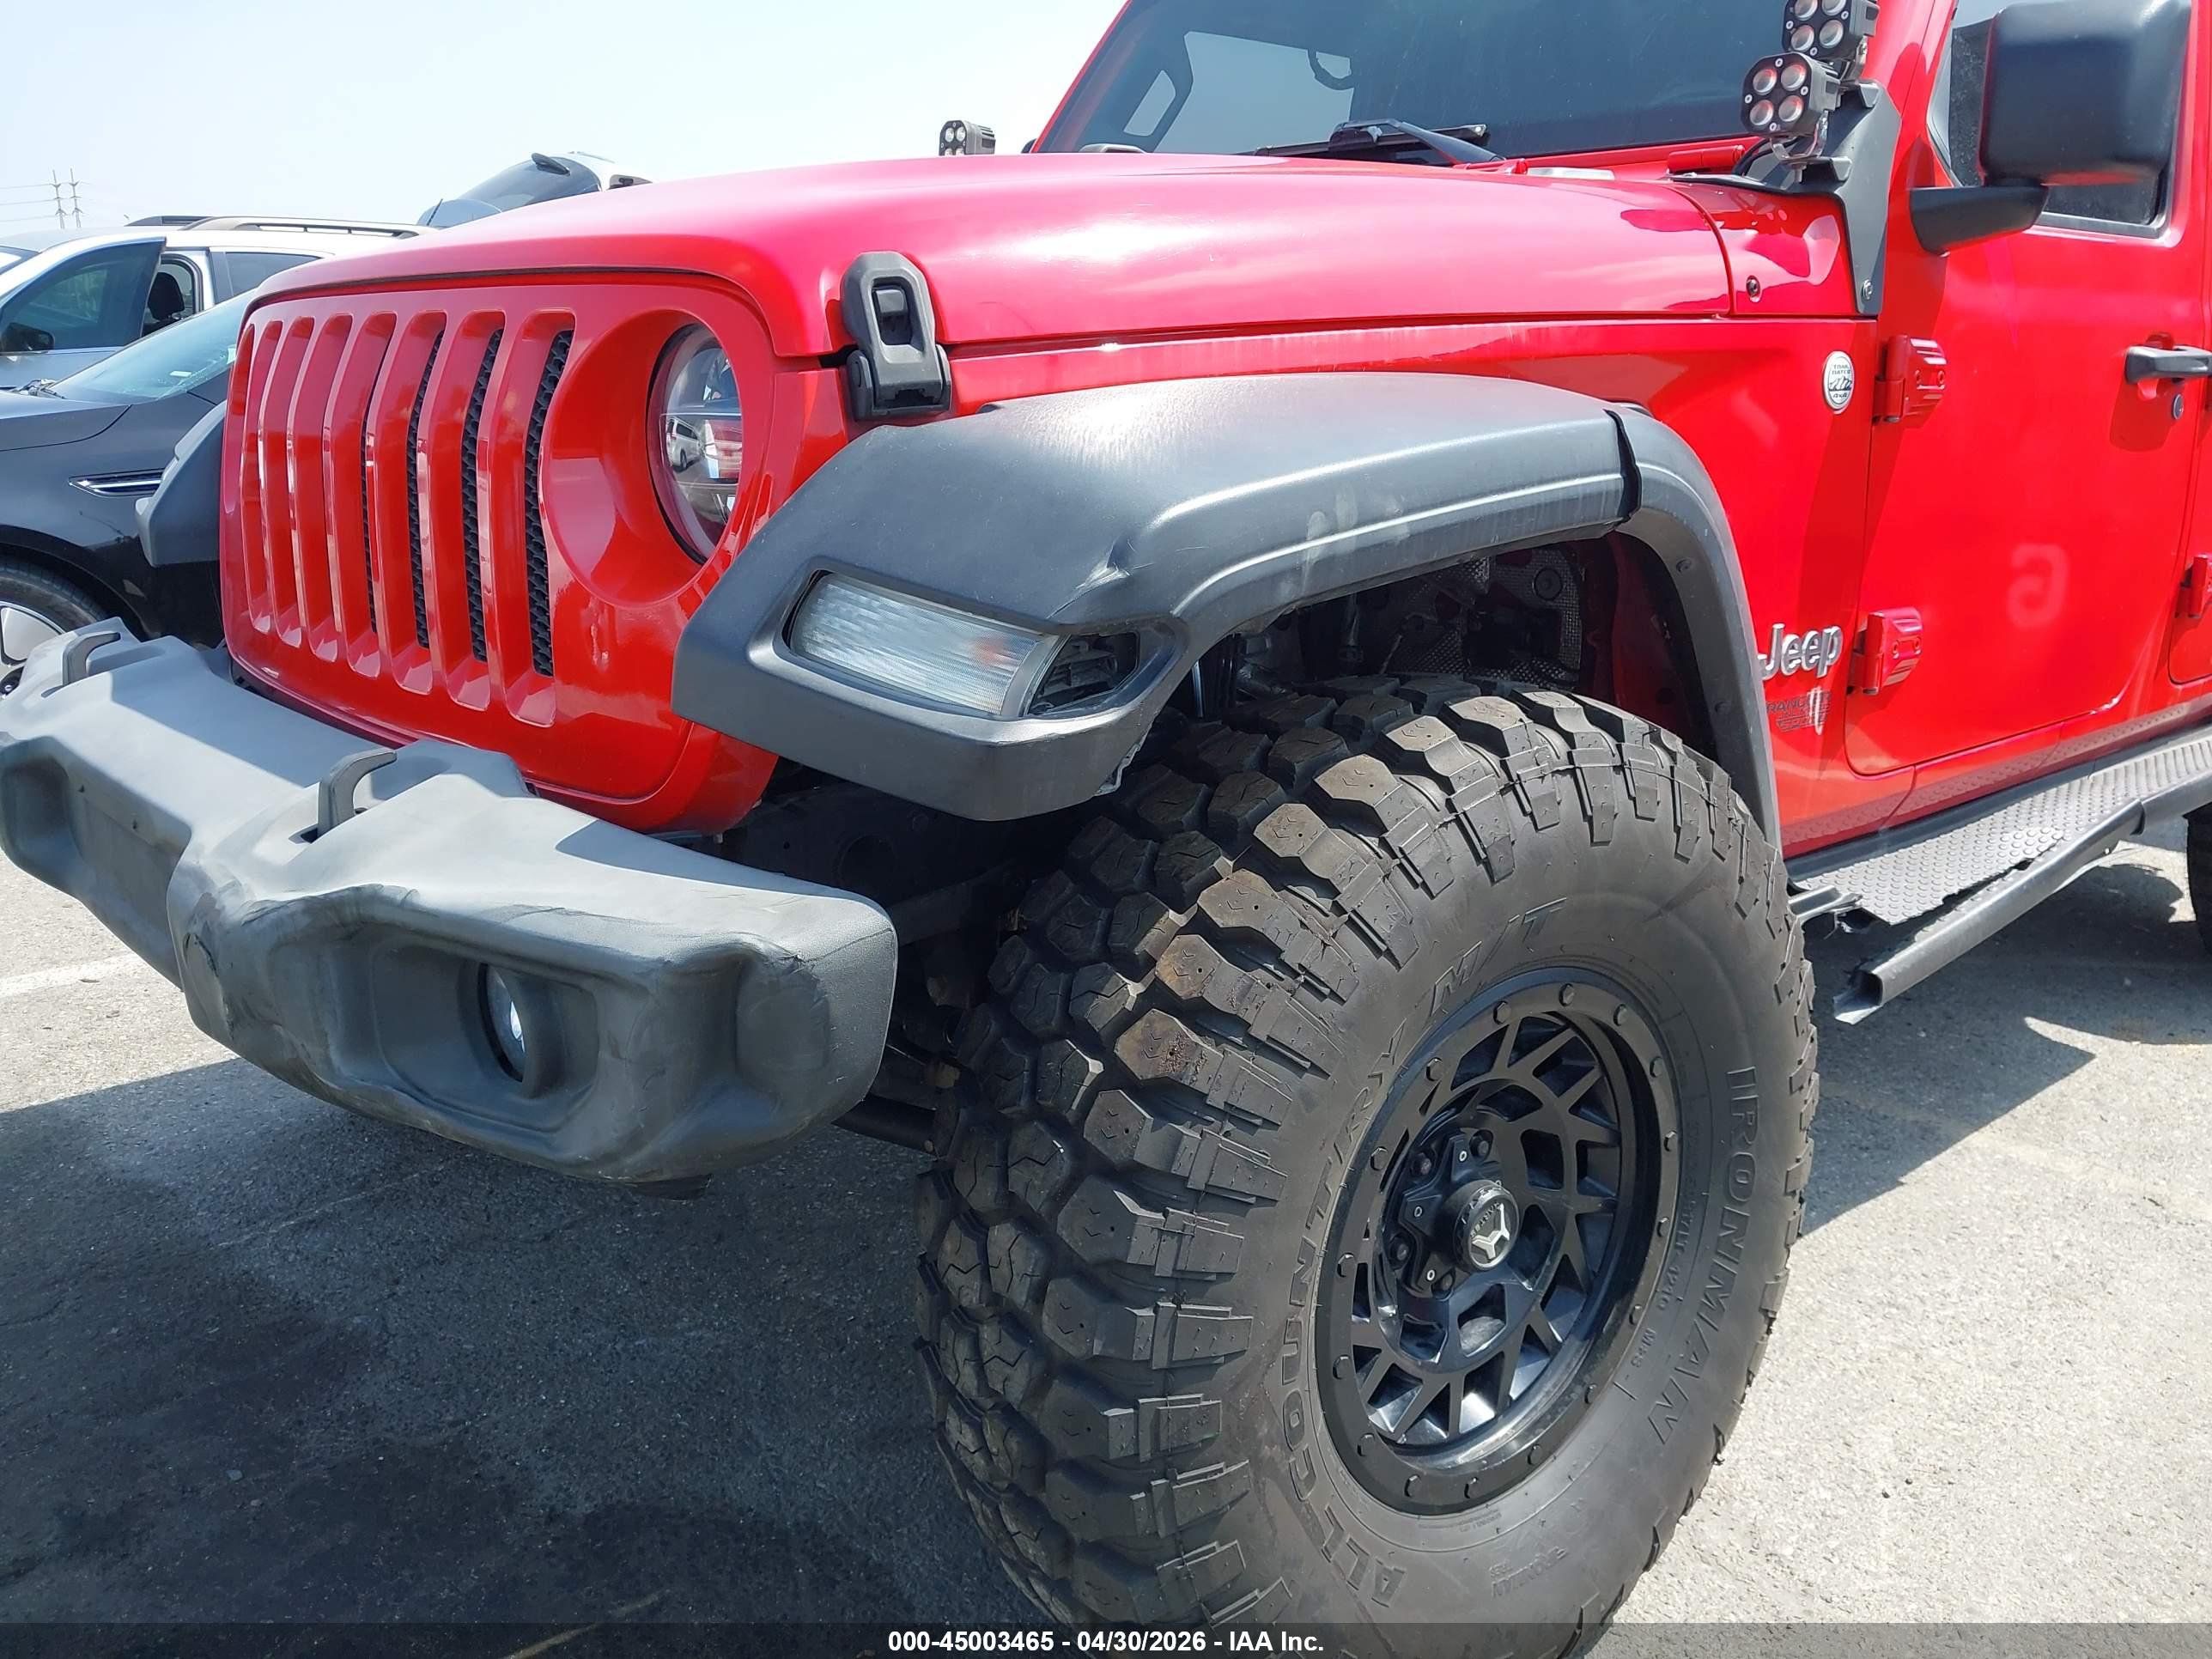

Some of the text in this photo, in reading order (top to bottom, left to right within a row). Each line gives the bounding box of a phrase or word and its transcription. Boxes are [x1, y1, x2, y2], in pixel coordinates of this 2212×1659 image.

[1758, 623, 1843, 681] Jeep
[1282, 1018, 1407, 1502] COUNTRY
[1648, 1066, 1759, 1444] IRONMAN
[1321, 1504, 1407, 1609] ALL
